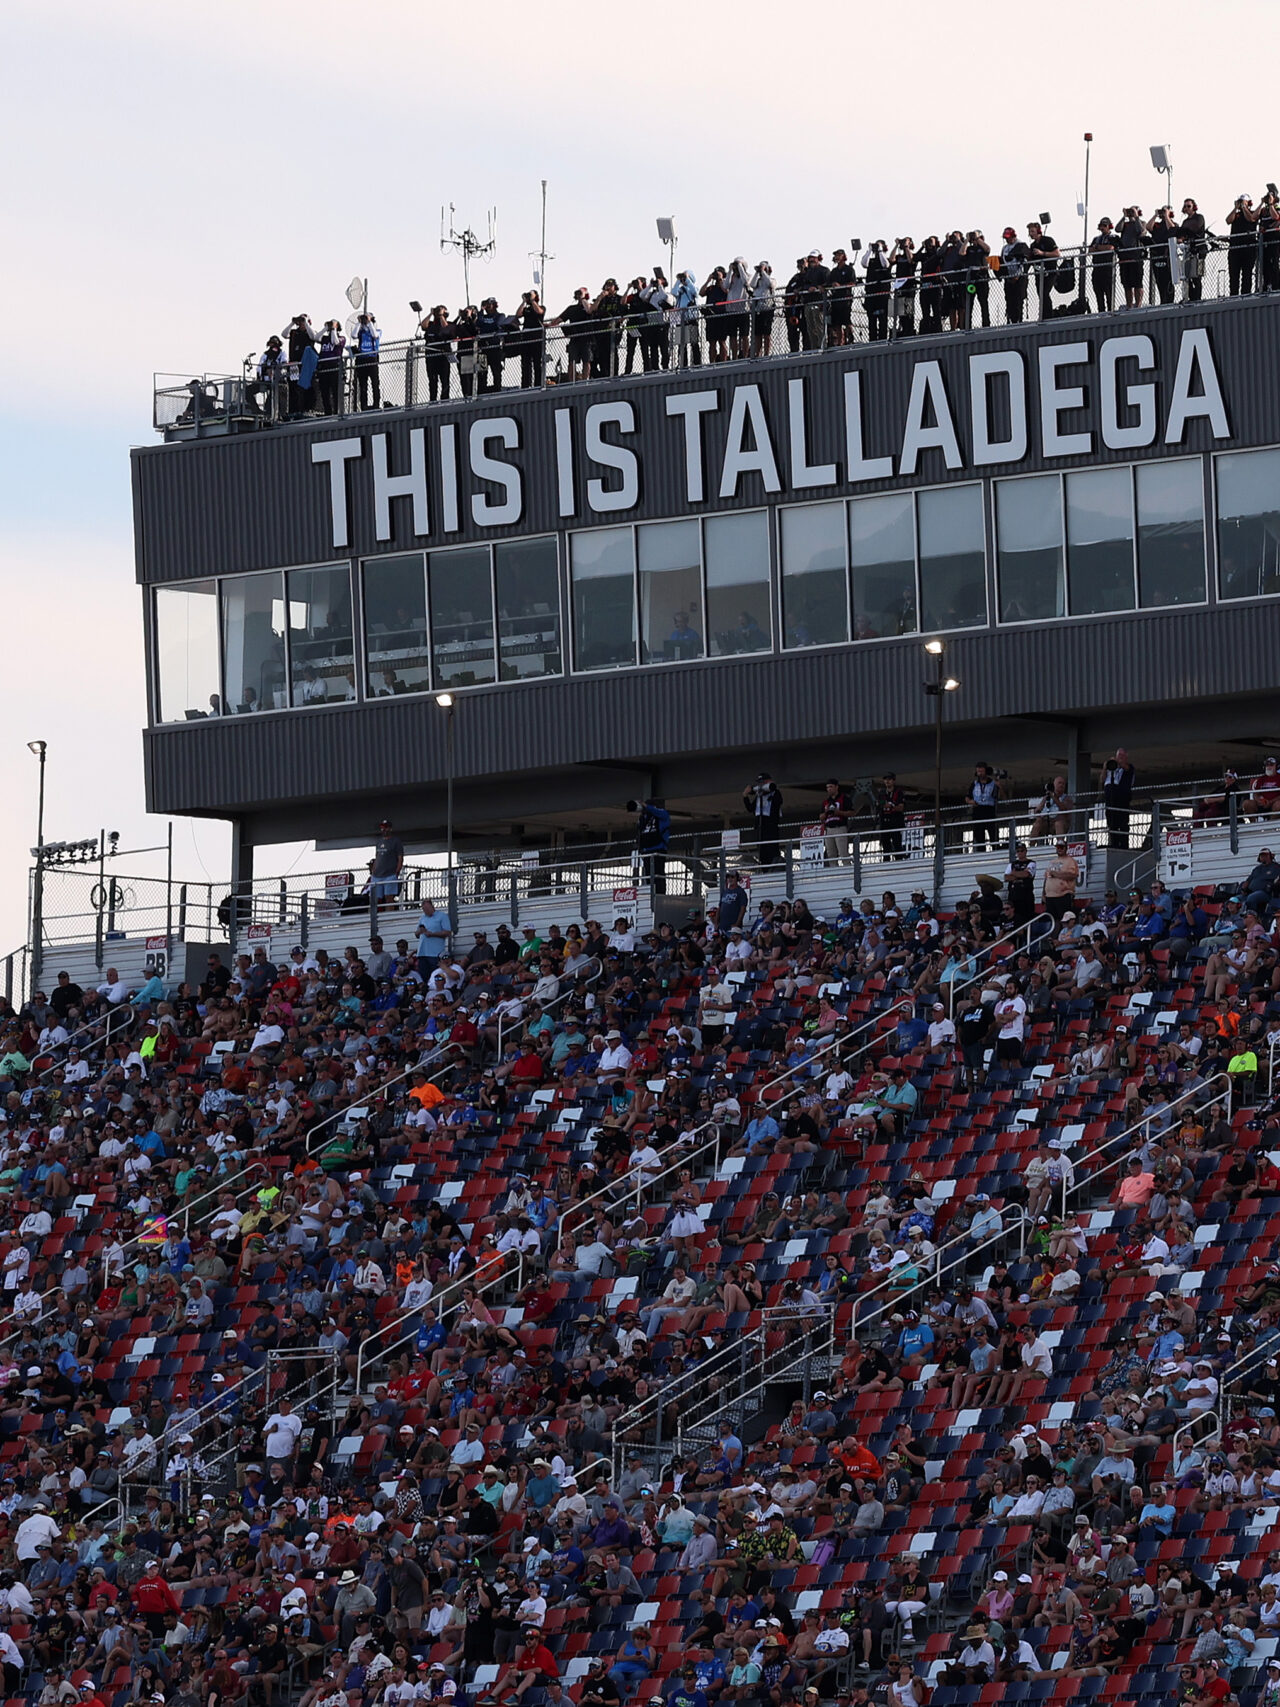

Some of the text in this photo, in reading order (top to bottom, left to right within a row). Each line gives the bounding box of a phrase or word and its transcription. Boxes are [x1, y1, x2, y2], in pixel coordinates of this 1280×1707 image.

[311, 328, 1230, 547] THIS IS TALLADEGA
[1168, 861, 1178, 876] T
